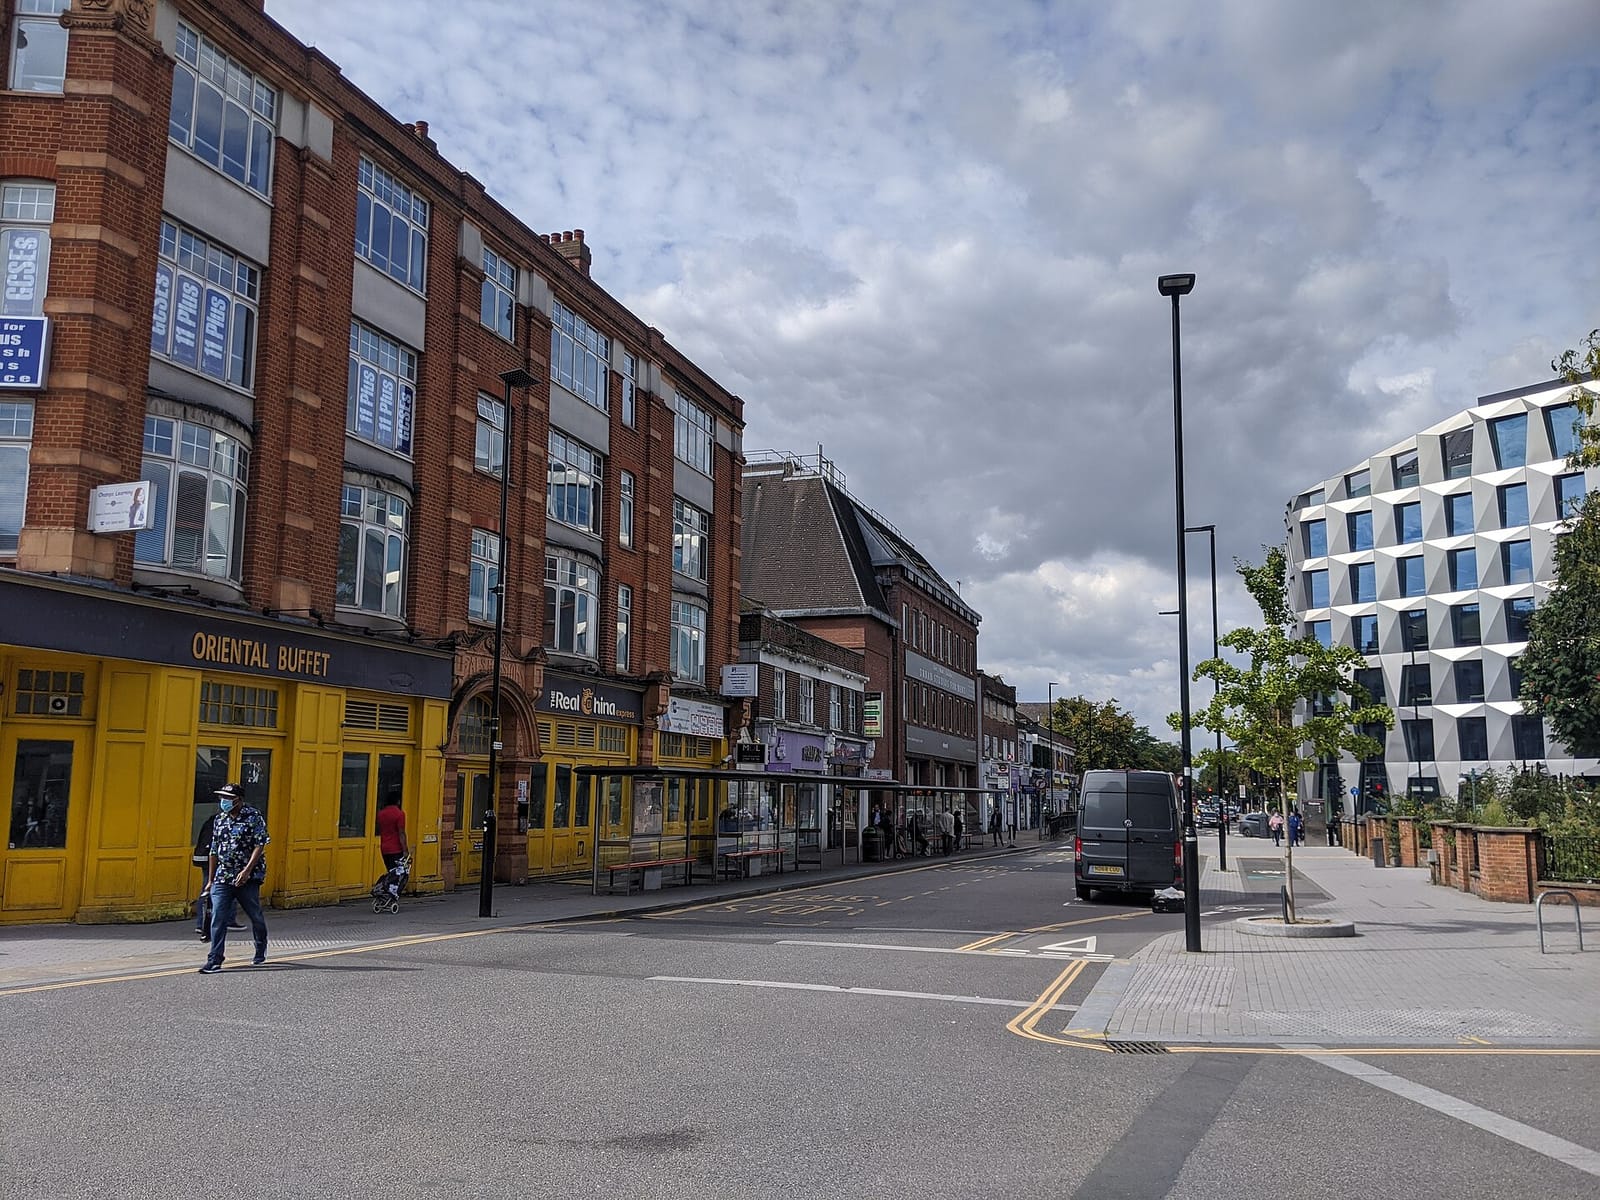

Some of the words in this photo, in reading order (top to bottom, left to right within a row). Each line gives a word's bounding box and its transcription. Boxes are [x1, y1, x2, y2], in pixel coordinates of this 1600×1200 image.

[177, 281, 199, 328] Plus
[205, 296, 227, 340] Plus
[0, 334, 22, 345] us
[3, 322, 26, 331] for
[175, 325, 196, 348] 11
[3, 348, 31, 358] sh
[203, 339, 223, 360] 11
[3, 374, 31, 383] ce
[360, 370, 375, 407] Plus
[380, 379, 394, 416] Plus
[192, 632, 270, 669] ORIENTAL
[278, 645, 331, 677] BUFFET
[555, 691, 580, 712] Real
[581, 688, 616, 715] China
[616, 709, 635, 719] express
